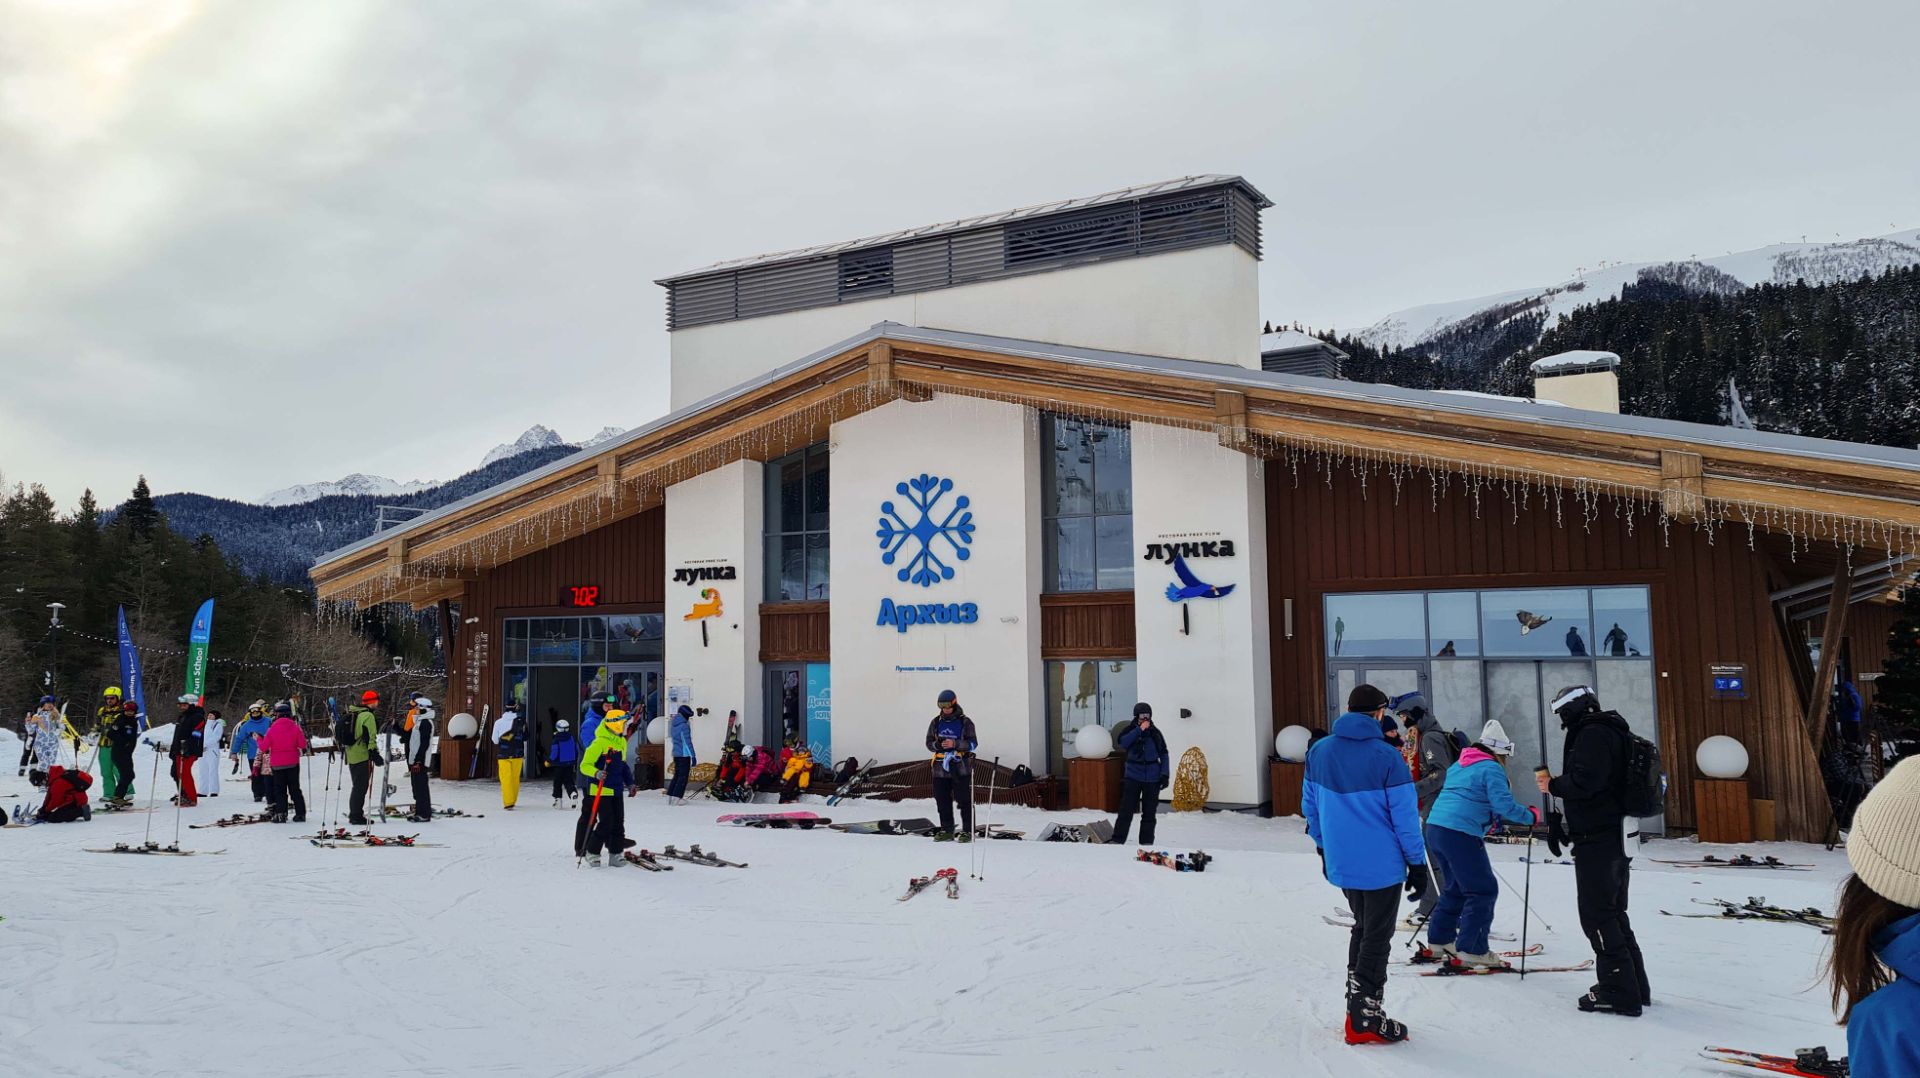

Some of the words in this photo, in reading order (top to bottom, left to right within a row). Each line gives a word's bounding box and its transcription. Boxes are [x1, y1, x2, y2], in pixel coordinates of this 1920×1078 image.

[1144, 540, 1235, 565] лунка
[673, 566, 736, 586] лунка
[876, 598, 978, 633] Архыз
[193, 647, 203, 675] School
